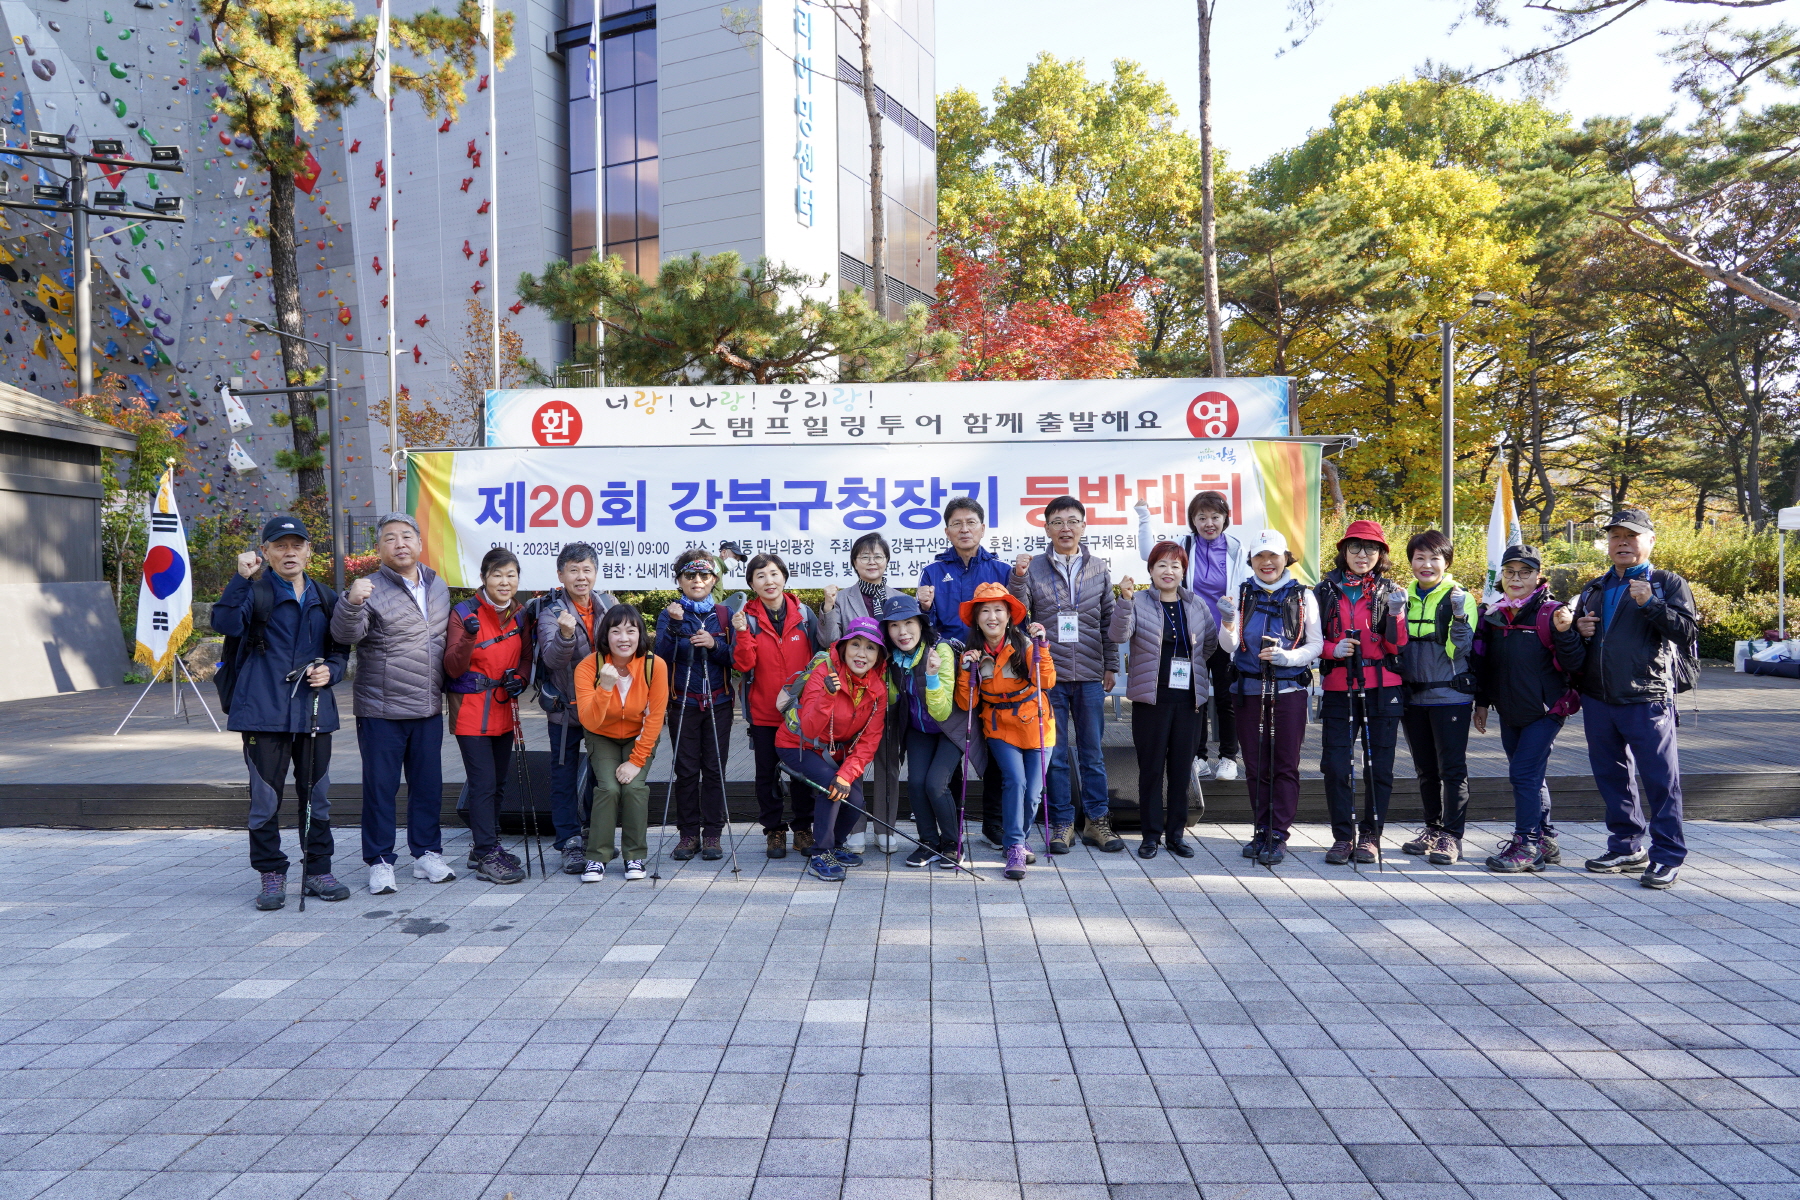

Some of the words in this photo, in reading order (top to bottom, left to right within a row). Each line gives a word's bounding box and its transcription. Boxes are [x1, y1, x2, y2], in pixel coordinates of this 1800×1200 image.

[796, 0, 813, 226] 라이밍센터
[606, 390, 673, 415] 너랑!
[689, 389, 756, 412] 나랑!
[772, 387, 873, 413] 우리랑!
[540, 408, 574, 444] 환
[963, 412, 1024, 434] 함께
[1035, 410, 1162, 433] 출발해요
[1193, 400, 1229, 438] 영
[474, 480, 646, 533] 제20회
[668, 476, 998, 532] 강북구청장기
[1020, 473, 1243, 528] 등반대회
[523, 541, 560, 556] 2023년
[637, 541, 670, 555] 09:00
[756, 539, 814, 555] 만남의광장
[829, 539, 852, 554] 주최
[989, 536, 1013, 552] 후원
[1023, 536, 1051, 552] 강북
[602, 563, 625, 579] 협찬
